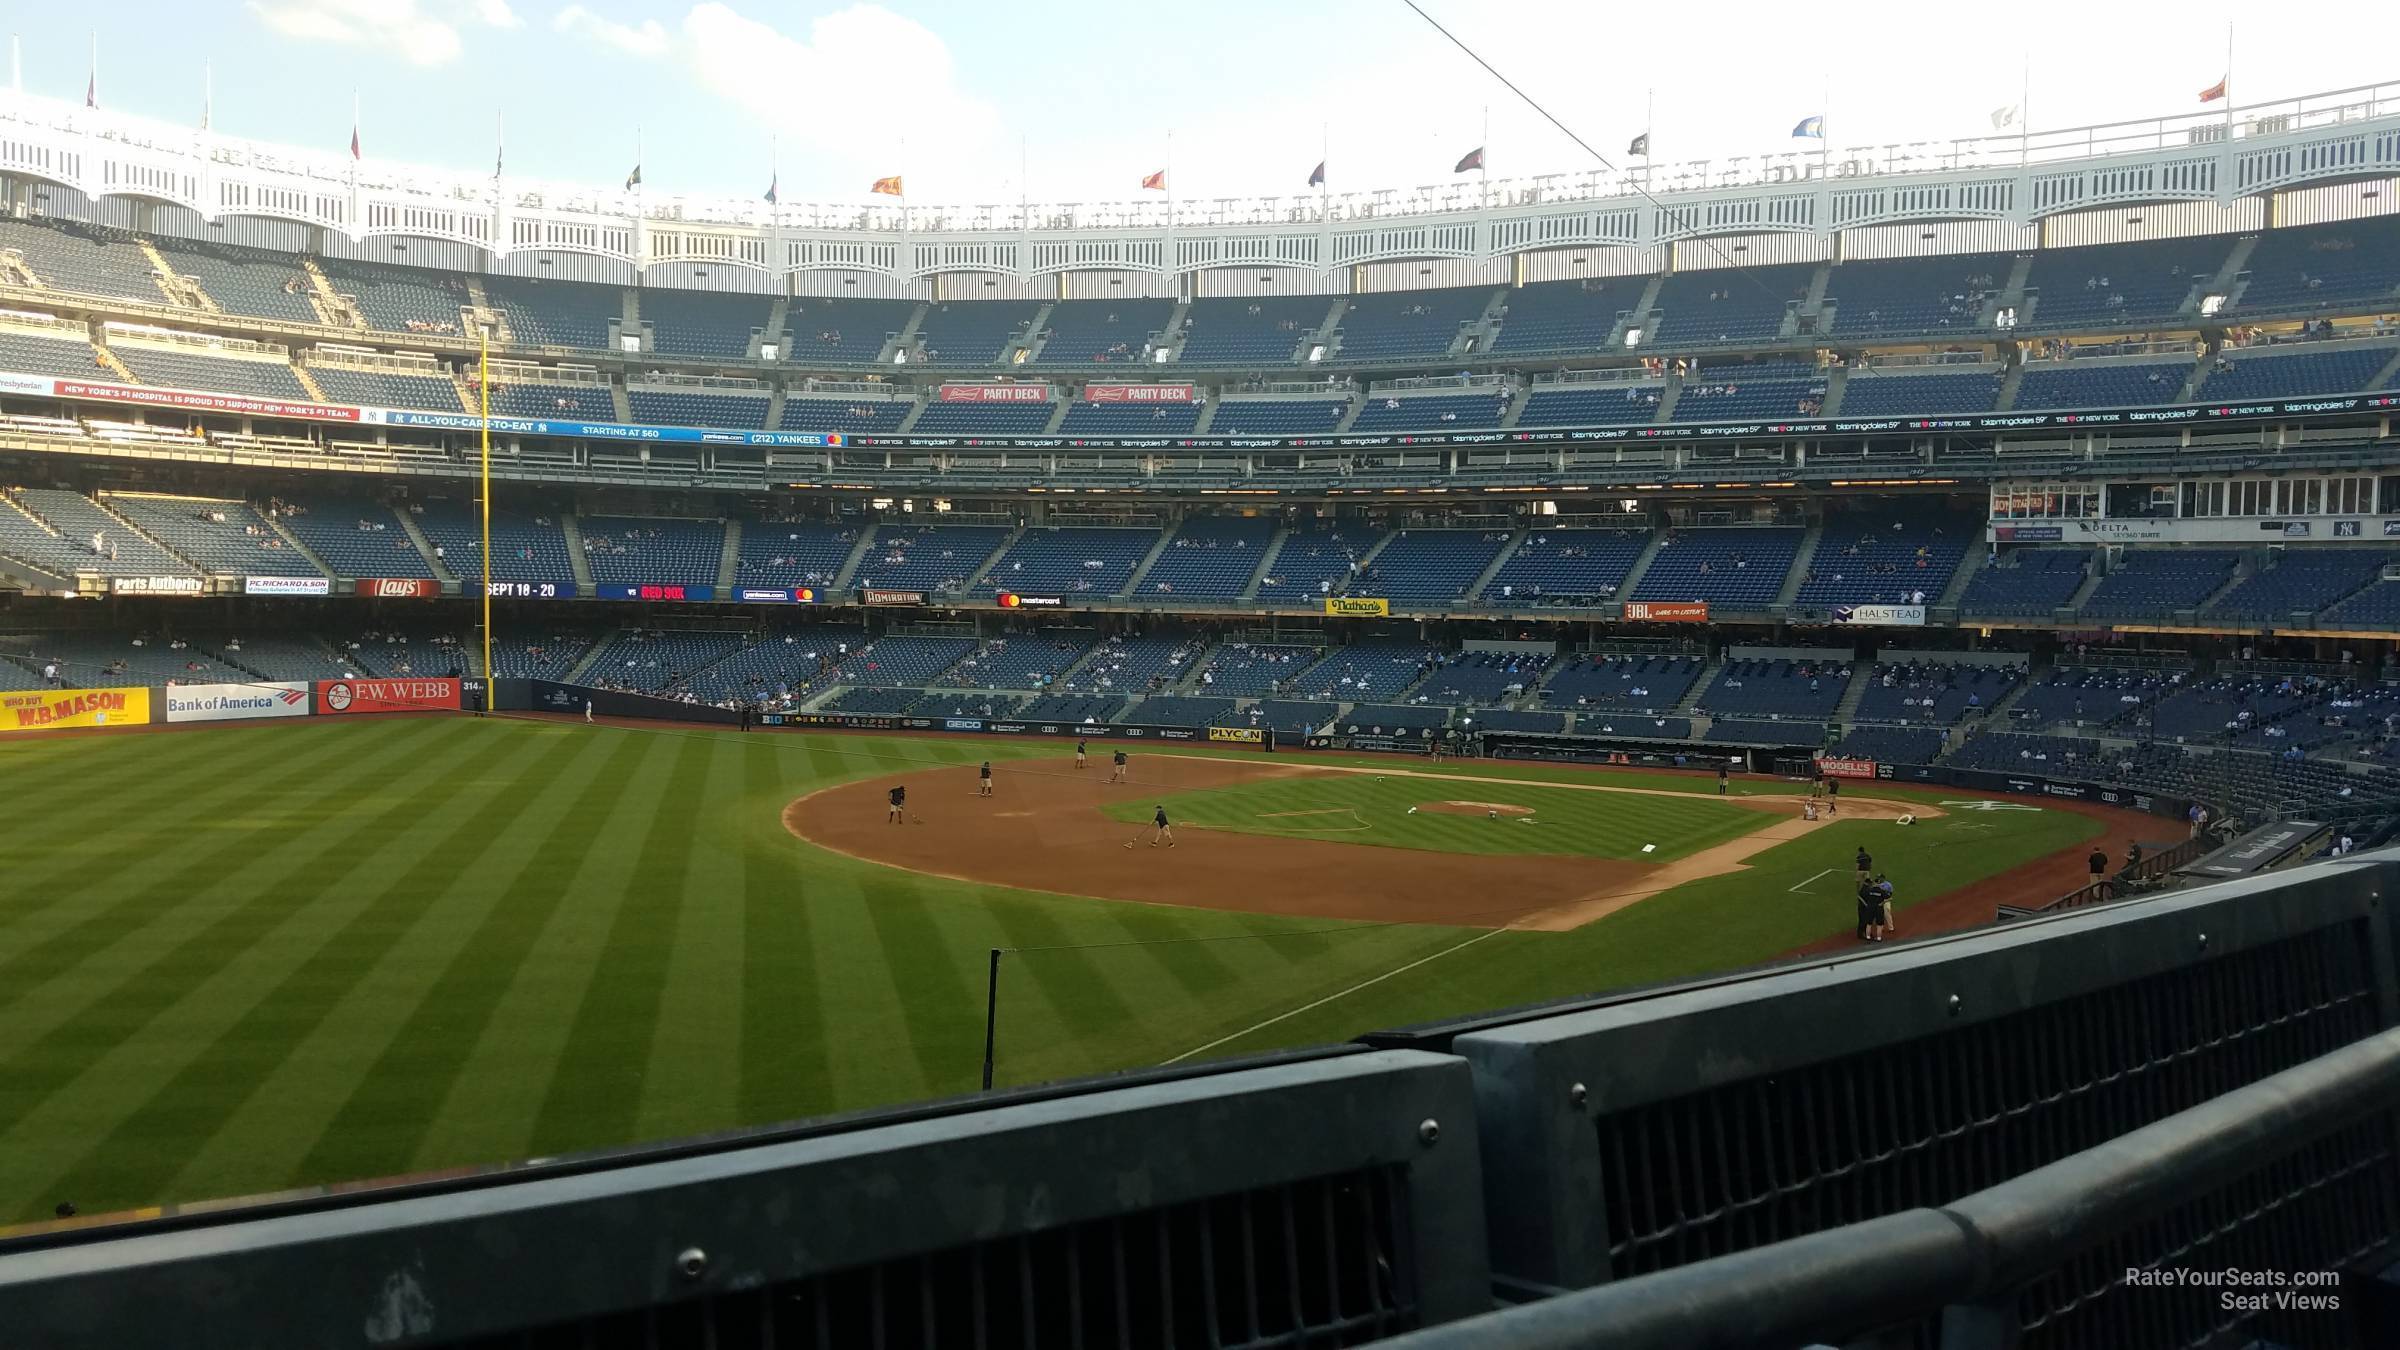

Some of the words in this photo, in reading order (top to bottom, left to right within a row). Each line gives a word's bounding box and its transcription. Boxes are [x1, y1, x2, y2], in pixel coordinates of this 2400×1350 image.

[0, 380, 42, 390] resbyterian
[65, 385, 85, 393] NEW
[88, 386, 118, 397] YORK'S
[121, 390, 130, 398] #1
[132, 391, 171, 401] HOSPITAL
[175, 394, 183, 402] IS
[184, 396, 212, 405] PROUD
[227, 401, 261, 410] SUPPORT
[264, 403, 281, 411] NEW
[284, 405, 314, 415] YORK'S
[984, 388, 1012, 400] PARTY
[1015, 389, 1040, 400] DECK
[1128, 388, 1157, 399] PARTY
[1160, 388, 1186, 400] DECK
[2208, 408, 2220, 416] THE
[410, 416, 533, 430] ALL-YOU-CARE-TO-EAT
[582, 426, 626, 436] STARTING
[628, 428, 639, 437] AT
[642, 429, 659, 438] $60
[751, 434, 775, 444] (212)
[777, 435, 821, 444] YANKEES
[2093, 524, 2129, 532] DELTA
[115, 578, 147, 590] Parts
[148, 575, 202, 590] Authority
[379, 578, 416, 596] Lay's
[488, 582, 514, 596] SEPT
[517, 583, 530, 596] 18
[540, 583, 555, 597] 20
[627, 588, 636, 596] vs
[641, 585, 662, 599] RED
[664, 585, 684, 600] SOX
[867, 591, 921, 602] ADMIRATION
[1021, 597, 1060, 605] mastercard
[1332, 599, 1382, 611] Nathan's
[1628, 604, 1652, 619] JBL
[1860, 609, 1920, 619] HALSTEAD
[355, 683, 388, 700] F.W.
[391, 682, 450, 700] WEBB
[463, 682, 478, 691] 314
[4, 697, 25, 707] WHO
[25, 695, 42, 704] BUT
[168, 698, 203, 711] Bank
[204, 697, 218, 710] of
[220, 696, 273, 709] America
[1211, 728, 1259, 738] PLYCON
[1821, 761, 1871, 771] MODELL'S
